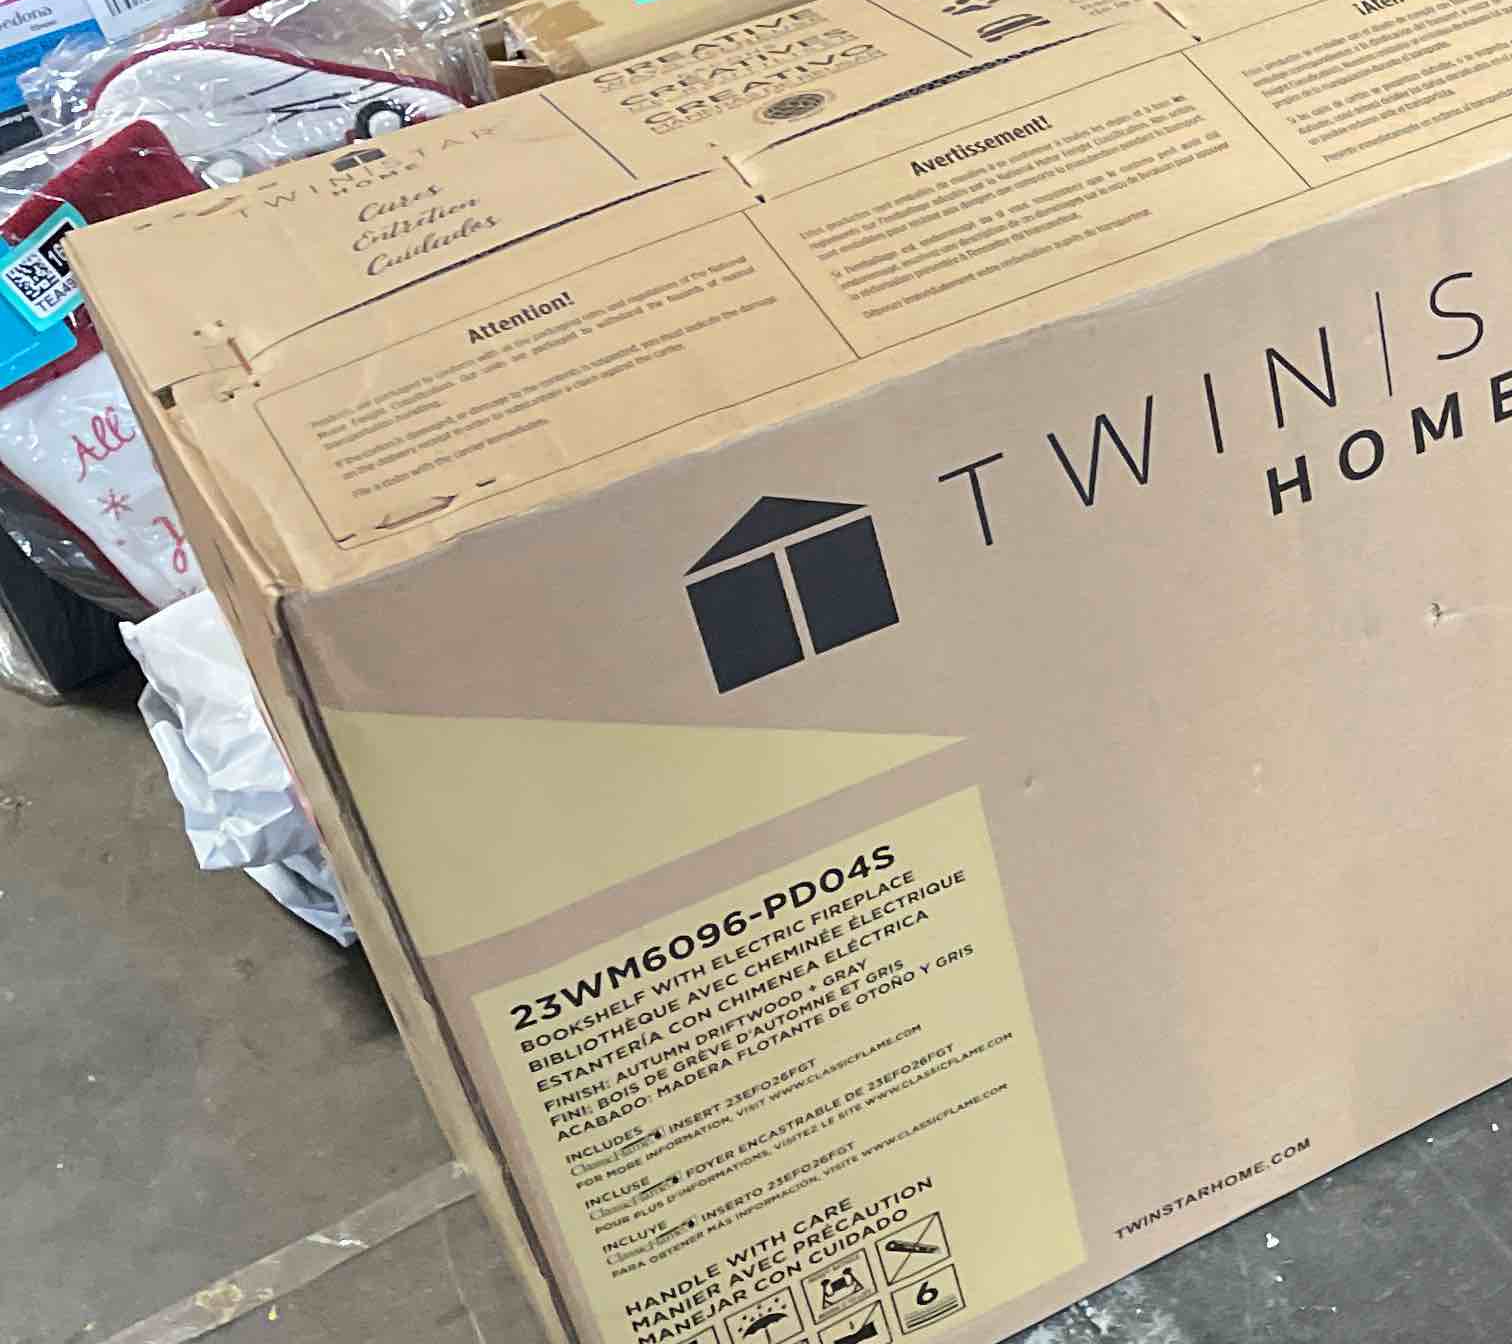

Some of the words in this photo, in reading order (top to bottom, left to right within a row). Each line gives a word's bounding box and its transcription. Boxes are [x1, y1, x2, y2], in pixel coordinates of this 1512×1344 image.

[0, 4, 54, 30] edona
[644, 44, 874, 125] CREATIVO
[908, 115, 1052, 178] Avertissement!
[466, 290, 575, 345] Attention!
[71, 406, 137, 483] All
[507, 841, 896, 1033] 23WM6096-PD04S
[519, 989, 647, 1054] BOOKSHELF
[651, 963, 706, 998] WITH
[711, 918, 806, 971] ELECTRIC
[809, 869, 915, 926] FIREPLACE
[527, 997, 681, 1074] BIBLIOTHÈQUE
[685, 971, 739, 1005] AVEC
[742, 923, 844, 979] CHEMINÉE
[847, 869, 966, 931] ÉLECTRIQUE
[535, 1027, 663, 1094] ESTANTERÍA
[667, 1006, 712, 1036] CON
[717, 957, 819, 1013] CHIMENEA
[823, 907, 929, 965] ELÉCTRICA
[543, 1077, 610, 1115] FINISH:
[613, 1040, 690, 1083] AUTUMN
[694, 988, 803, 1046] DRIFTWOOD
[822, 958, 868, 988] GRAY
[596, 1080, 640, 1110] BOIS
[643, 1067, 669, 1087] DE
[839, 978, 861, 997] ET
[865, 958, 904, 985] GRIS
[656, 1055, 733, 1098] MADERA
[736, 1012, 824, 1061] FLOTANTE
[828, 1000, 850, 1018] DE
[935, 942, 974, 969] GRIS
[564, 1124, 643, 1166] INCLUDES
[668, 1102, 721, 1134] INSERT
[685, 1149, 734, 1178] FOYER
[737, 1097, 841, 1154] ENCASTRABLE
[844, 1086, 864, 1103] DE
[575, 1174, 603, 1190] FOR
[605, 1156, 642, 1179] MORE
[584, 1175, 650, 1211] INCLUSE
[632, 1198, 664, 1220] PLUS
[701, 1186, 763, 1222] INSERTO
[1113, 1136, 1312, 1240] TWINSTARHOME.COM
[601, 1219, 668, 1256] INCLUYE
[624, 1262, 721, 1319] HANDLE
[725, 1230, 786, 1269] WITH
[791, 1197, 852, 1236] CARE
[630, 1282, 721, 1334] MANIER
[726, 1248, 787, 1287] AVEC
[792, 1176, 933, 1255] PRÉCAUTION
[753, 1260, 802, 1294] CON
[807, 1206, 908, 1265] CUIDADO
